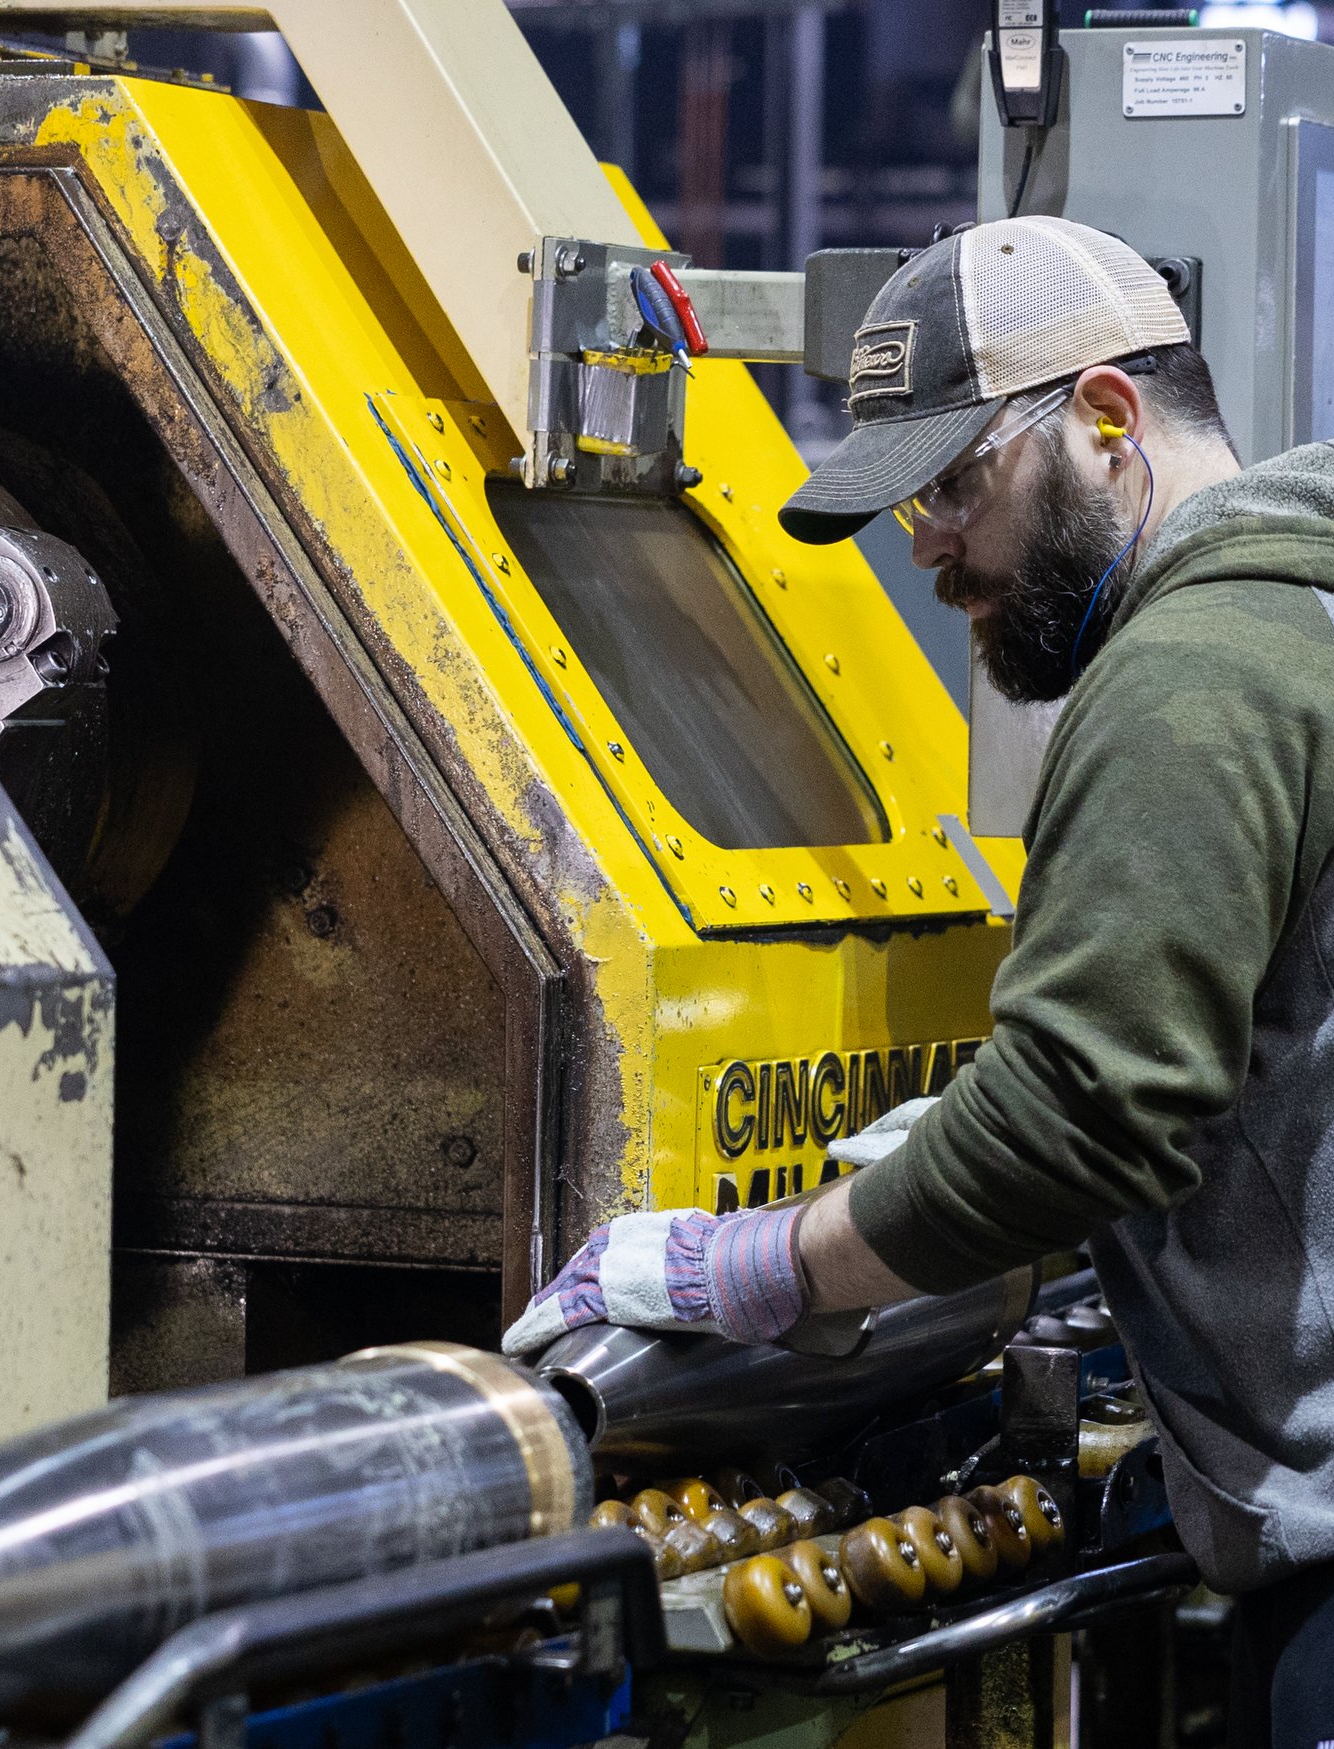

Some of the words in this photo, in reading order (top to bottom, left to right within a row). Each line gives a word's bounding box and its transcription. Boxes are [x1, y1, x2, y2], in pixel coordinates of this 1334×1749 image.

[1153, 52, 1174, 62] CNC
[1175, 51, 1228, 64] Engineering
[713, 1036, 993, 1161] CINCINNA
